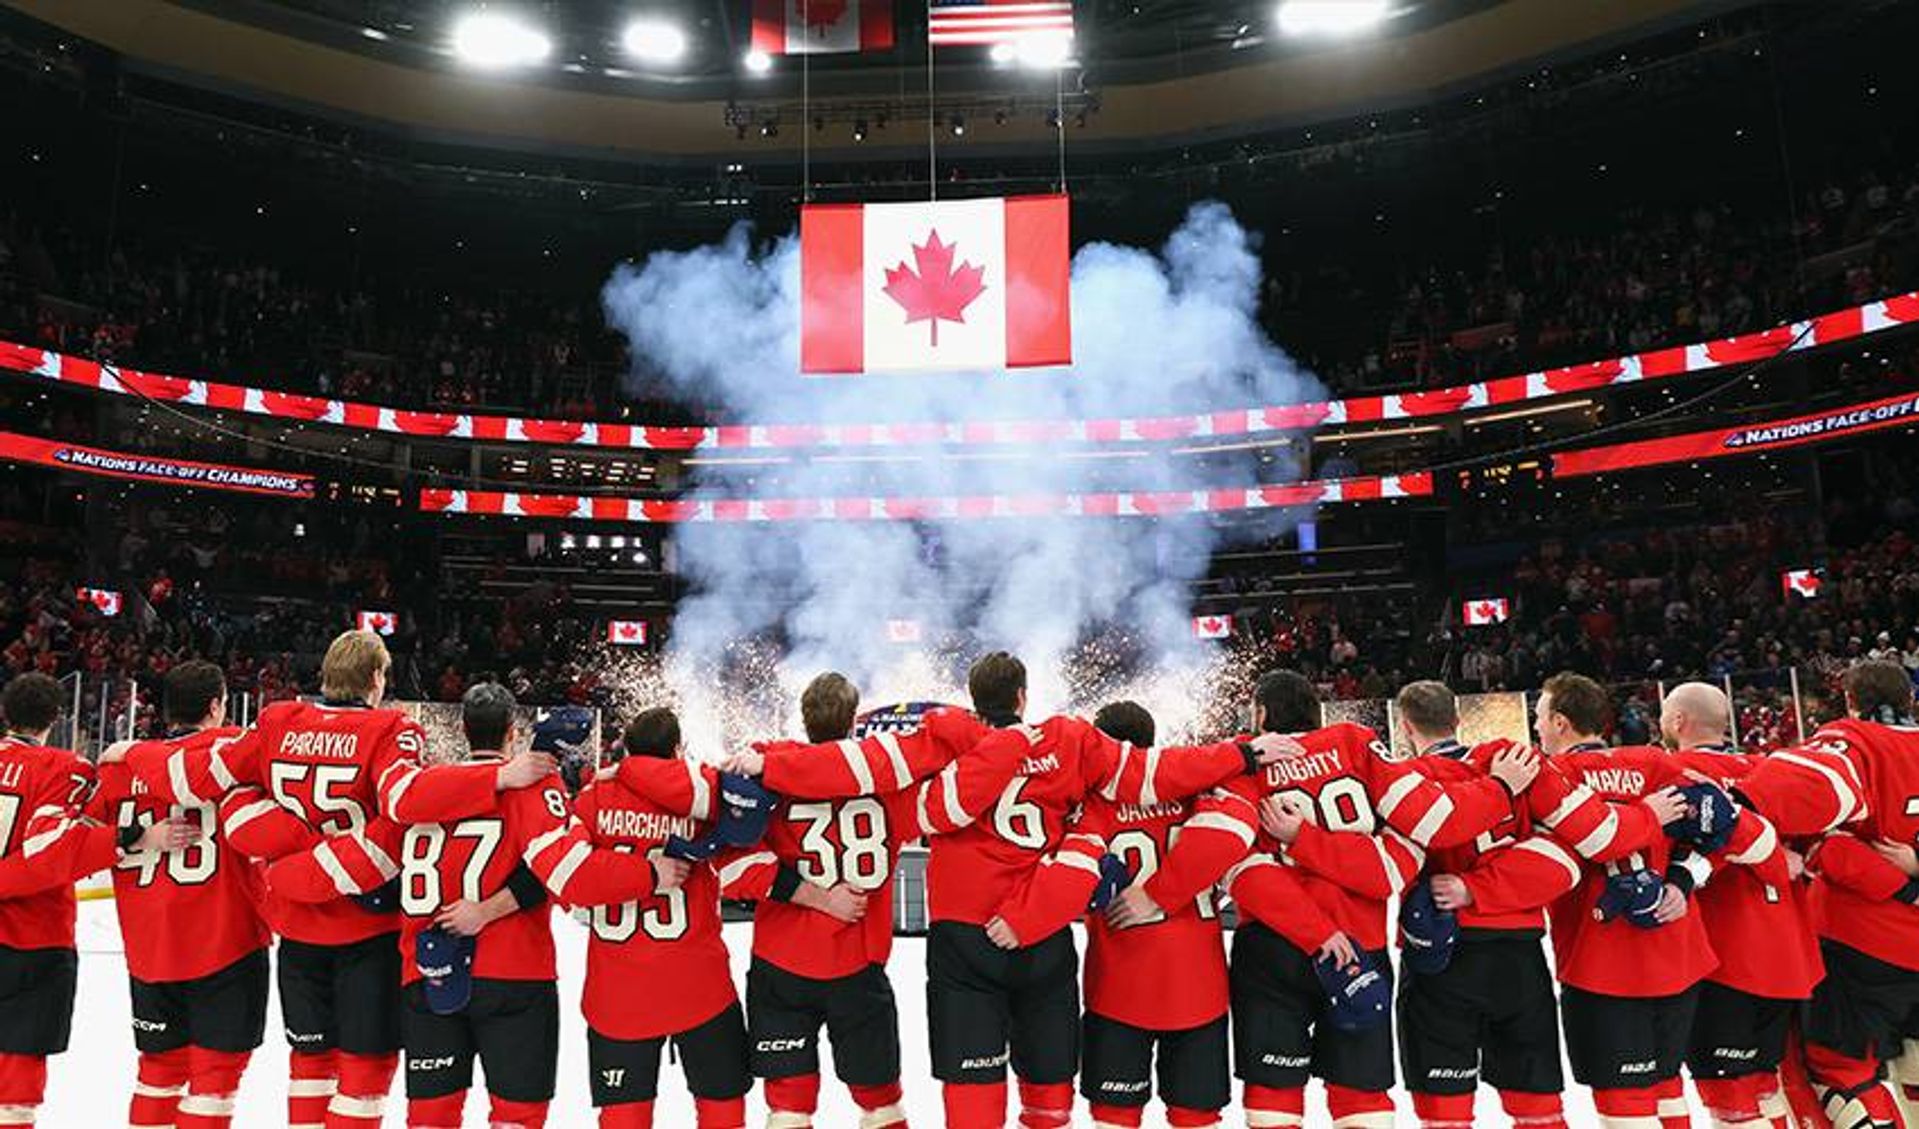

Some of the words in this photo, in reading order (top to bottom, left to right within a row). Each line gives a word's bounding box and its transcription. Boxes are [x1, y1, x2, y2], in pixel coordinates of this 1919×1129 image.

[1746, 420, 1823, 444] NATIONS
[1826, 401, 1911, 430] FACE-OFF
[72, 450, 136, 472] NATIONS
[138, 461, 207, 479] FACE-OFF
[208, 469, 297, 491] CHAMPIONS
[279, 730, 358, 758] PARAYKO
[271, 762, 363, 838] 55
[994, 776, 1047, 850] 6
[788, 798, 889, 890] 38
[401, 820, 503, 916] 87
[409, 1057, 455, 1070] CCM
[757, 1037, 806, 1051] CCM
